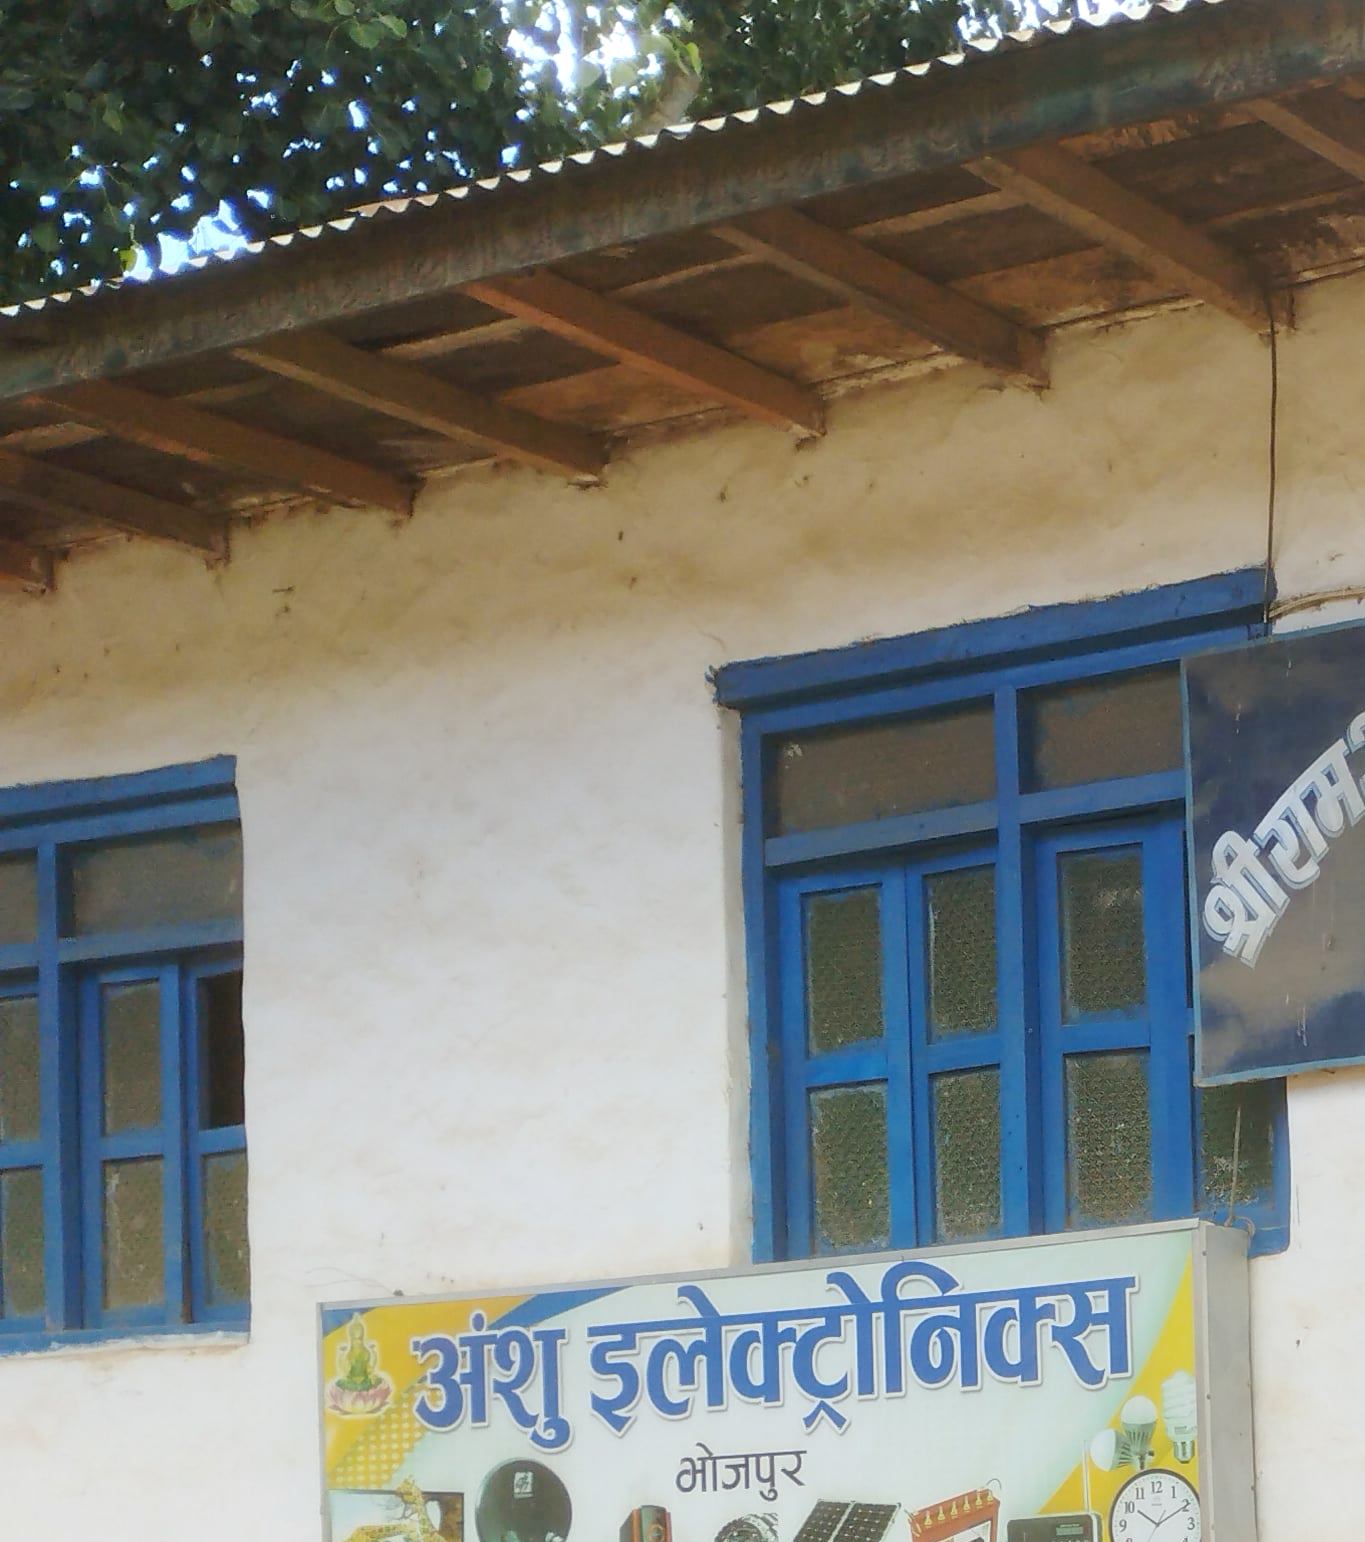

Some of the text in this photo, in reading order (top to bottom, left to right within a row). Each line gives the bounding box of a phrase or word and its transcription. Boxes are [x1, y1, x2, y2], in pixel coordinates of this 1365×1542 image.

[1202, 830, 1291, 969] श्री
[410, 1261, 1141, 1453] अंशु इलेक्ट्रोनिक्स
[675, 1443, 807, 1503] भोजपुर
